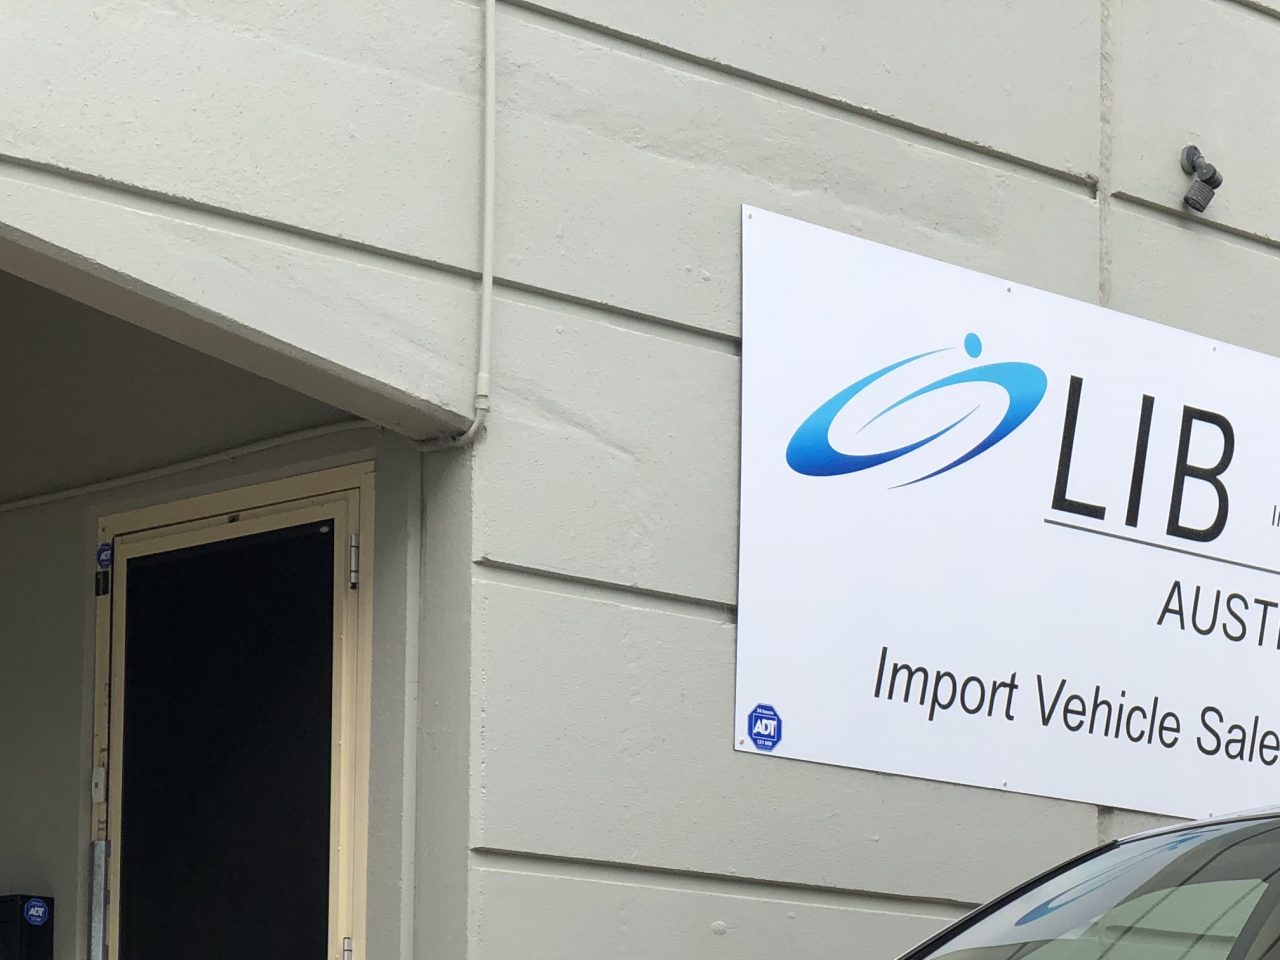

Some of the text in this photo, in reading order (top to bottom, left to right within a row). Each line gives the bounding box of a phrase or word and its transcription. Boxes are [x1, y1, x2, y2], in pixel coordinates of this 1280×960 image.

[1051, 375, 1235, 543] LIB
[753, 718, 777, 736] ADT
[873, 646, 1019, 722] Import
[1036, 674, 1182, 749] Vehicle
[28, 906, 45, 916] ADT
